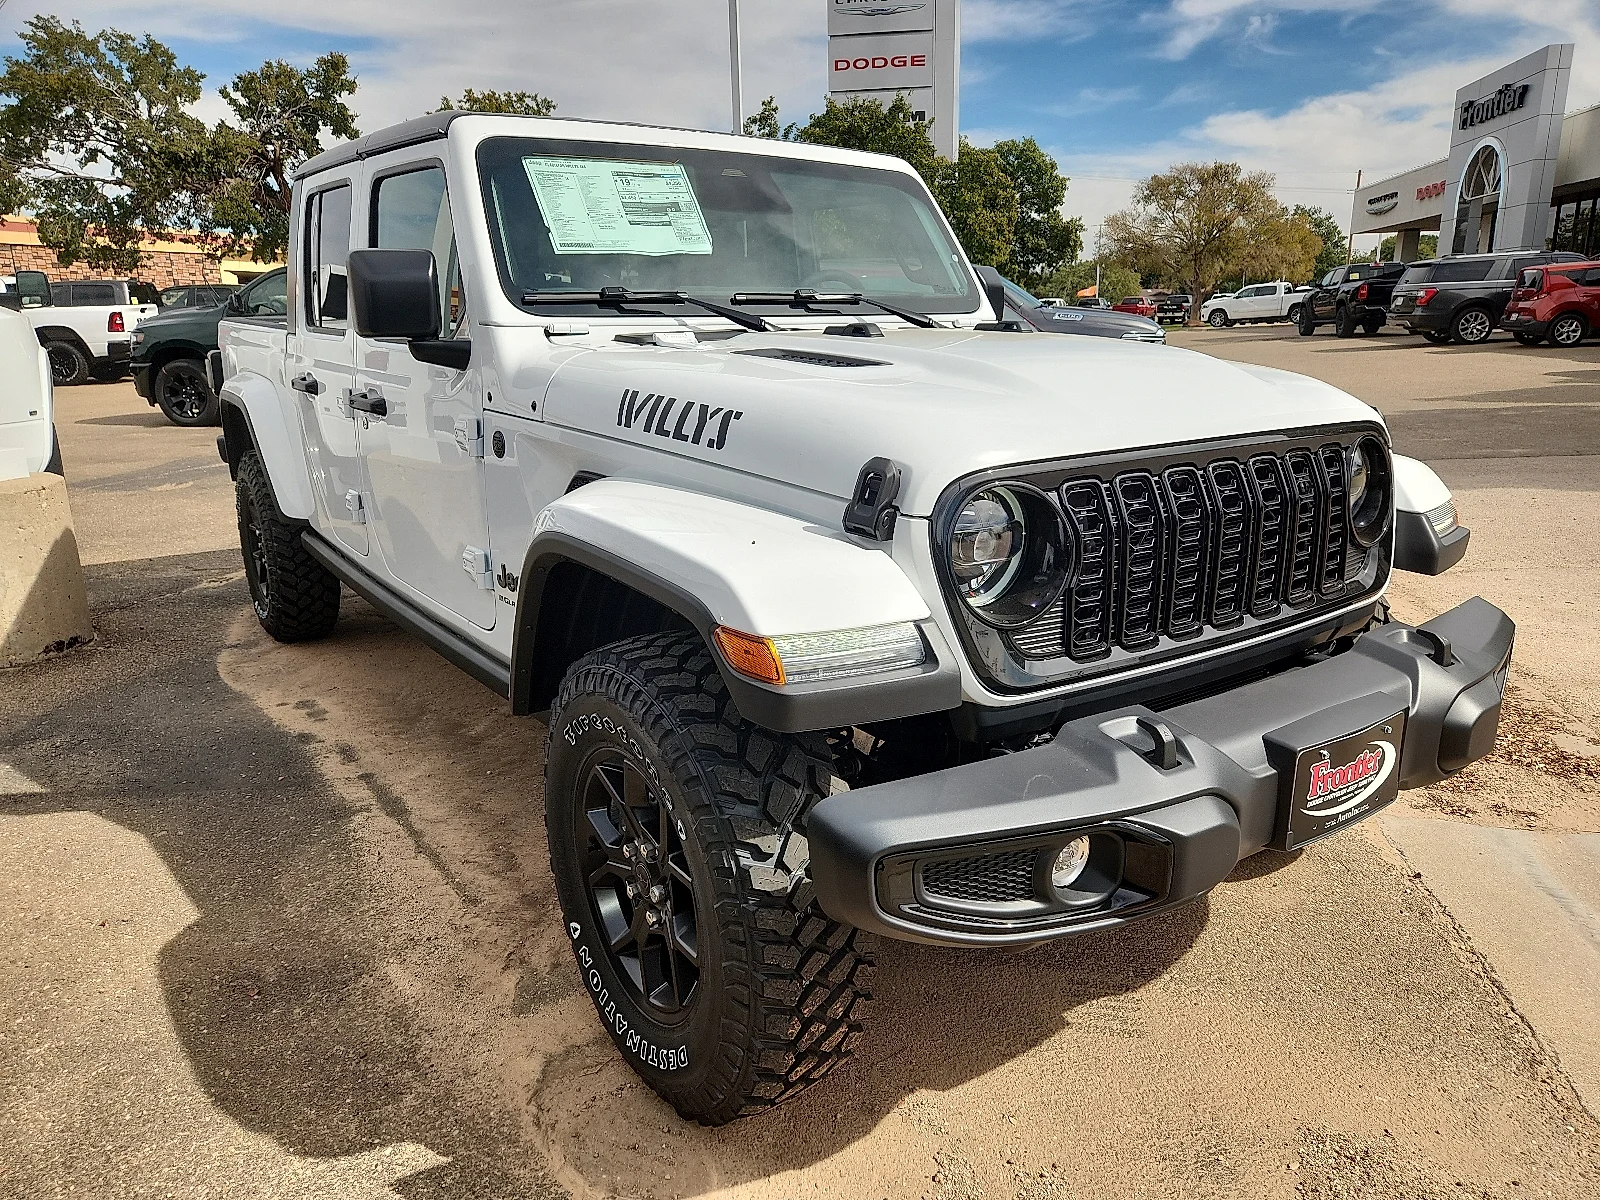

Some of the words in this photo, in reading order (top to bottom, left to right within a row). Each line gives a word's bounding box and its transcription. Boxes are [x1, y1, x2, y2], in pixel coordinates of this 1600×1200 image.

[834, 54, 926, 72] DODGE
[1459, 84, 1527, 130] Frontier
[1415, 180, 1447, 201] DODG
[616, 388, 743, 450] WILLYS
[1307, 748, 1382, 800] Frontier
[579, 945, 689, 1070] DESTINATION
